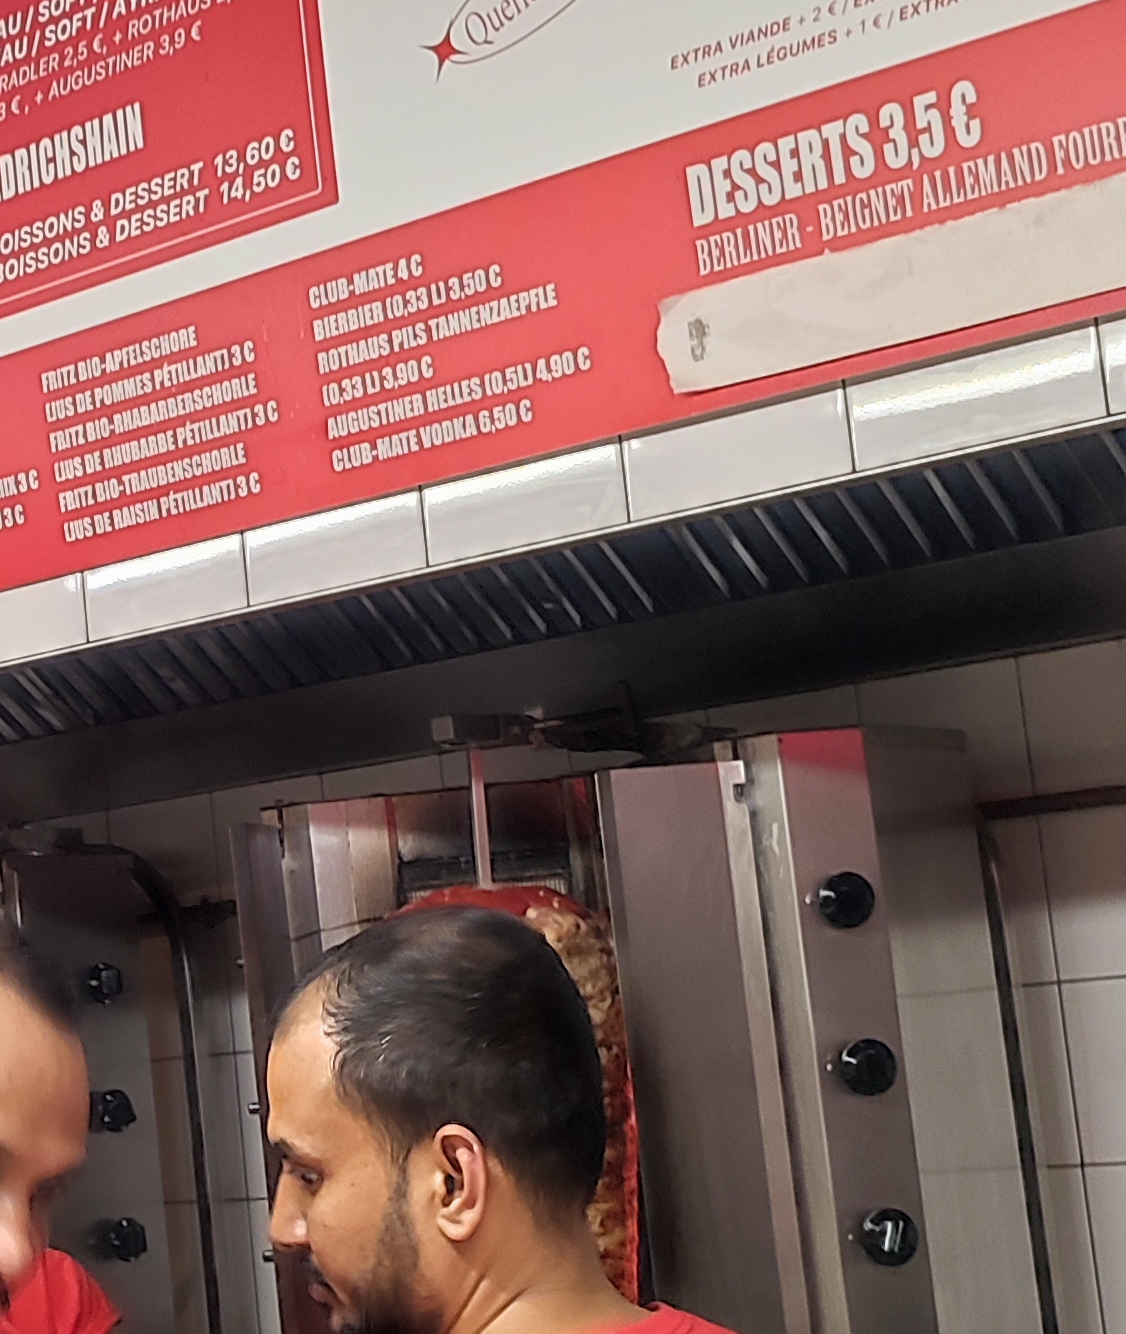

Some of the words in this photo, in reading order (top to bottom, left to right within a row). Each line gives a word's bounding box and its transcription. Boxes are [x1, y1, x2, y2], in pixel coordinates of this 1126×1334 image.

[90, 199, 104, 222] &
[110, 161, 203, 215] DESSERT
[214, 136, 274, 177] 13,60
[685, 113, 875, 227] DESSERTS
[879, 90, 945, 185] 3,5
[95, 225, 109, 248] &
[115, 188, 209, 241] DESSERT
[220, 163, 280, 204] 14,50
[695, 213, 801, 275] BERLINER
[818, 178, 913, 240] BEIGNET
[922, 142, 1047, 212] ALLEMAND
[41, 364, 76, 393] FRITZ
[77, 325, 197, 381] BIO-APFELSCHORE
[317, 333, 390, 374] ROTHAUS
[391, 322, 427, 352] PILS
[427, 283, 557, 341] TANNENZAEPFLE
[49, 424, 85, 453] FRITZ
[85, 373, 257, 441] BIO-RHABARBERSCHORLE
[331, 429, 419, 471] CLUB-MATE
[419, 414, 477, 448] VODKA
[478, 403, 517, 433] 6,50
[58, 485, 94, 512] FRITZ
[95, 442, 246, 501] BIO-TRAUBENSCHORLE
